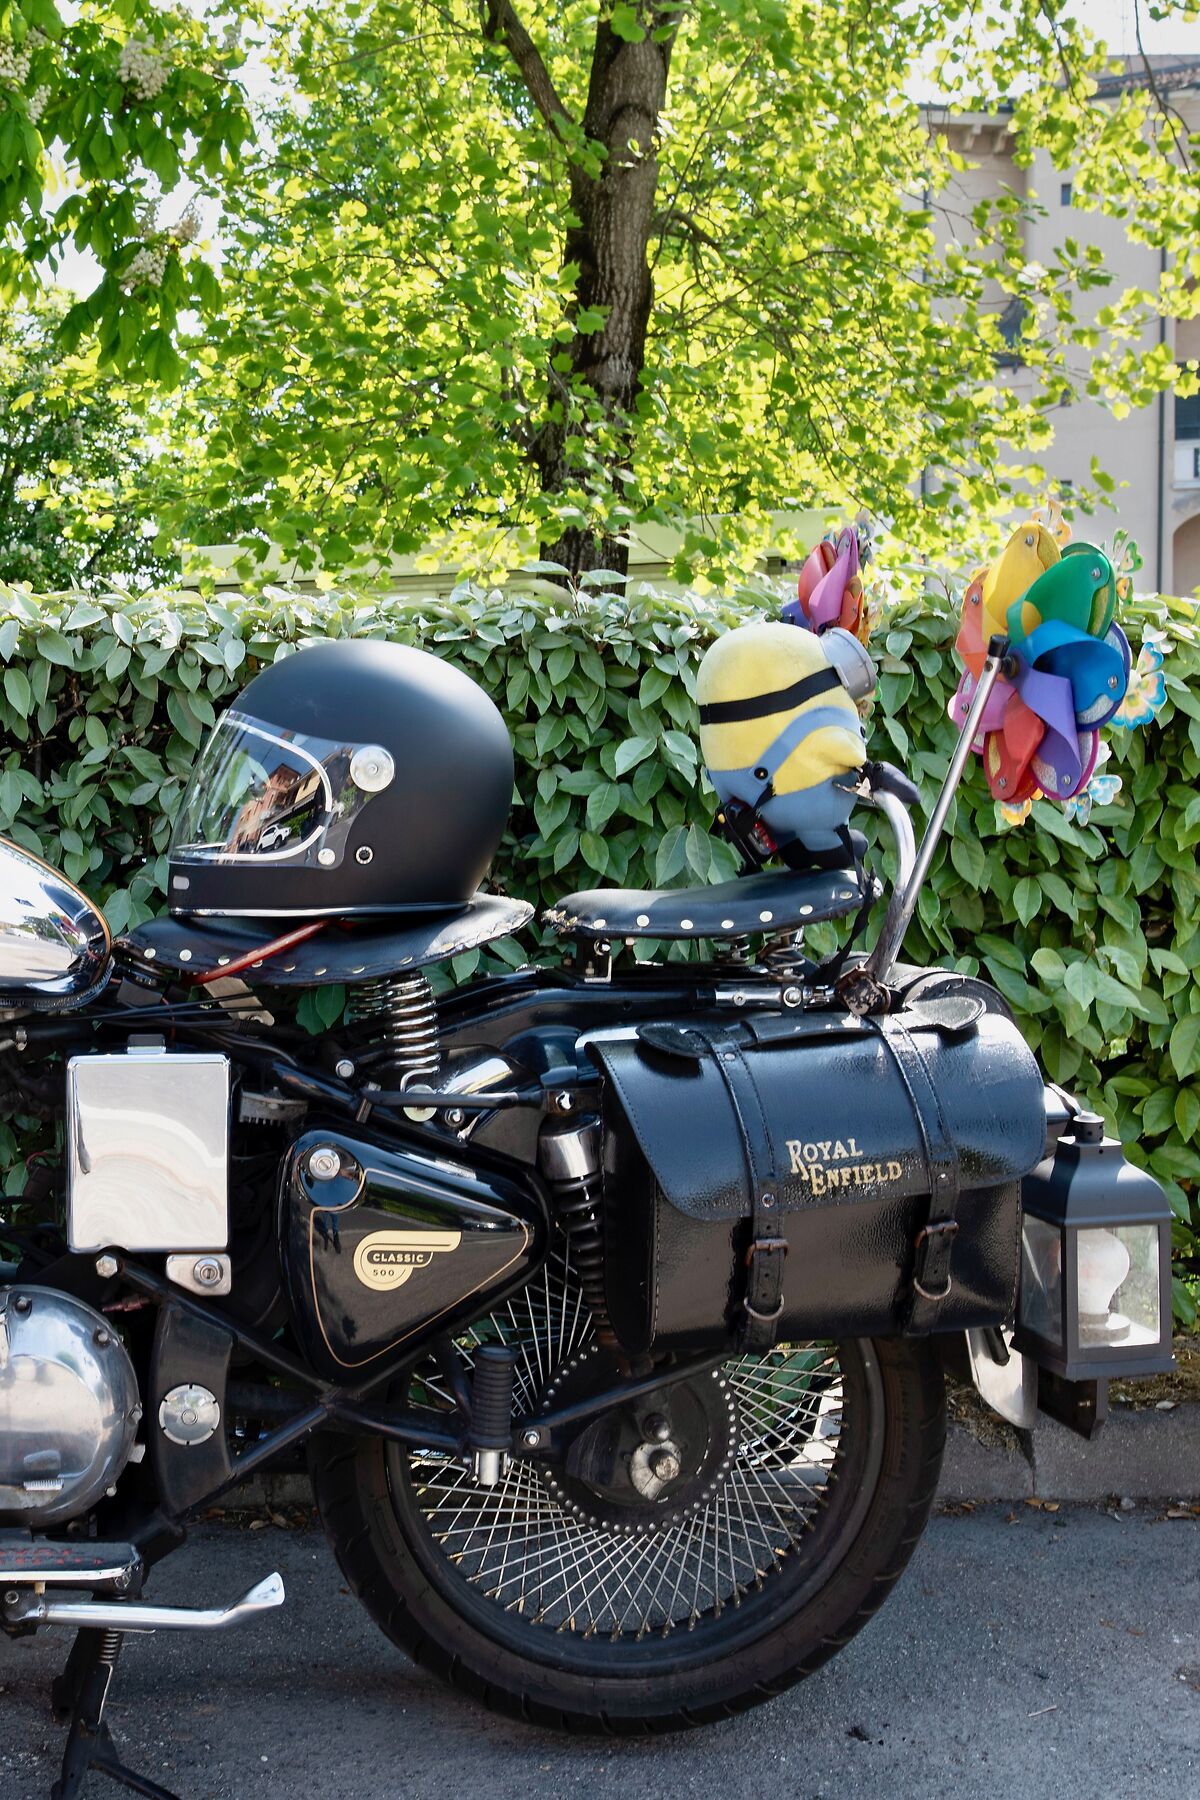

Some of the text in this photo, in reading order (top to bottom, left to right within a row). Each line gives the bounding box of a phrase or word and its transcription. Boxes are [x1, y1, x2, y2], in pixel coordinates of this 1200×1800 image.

[784, 1137, 864, 1182] ROYAL
[806, 1160, 904, 1197] ENFIELD
[371, 1252, 425, 1263] CLASSIC
[372, 1268, 396, 1277] 500
